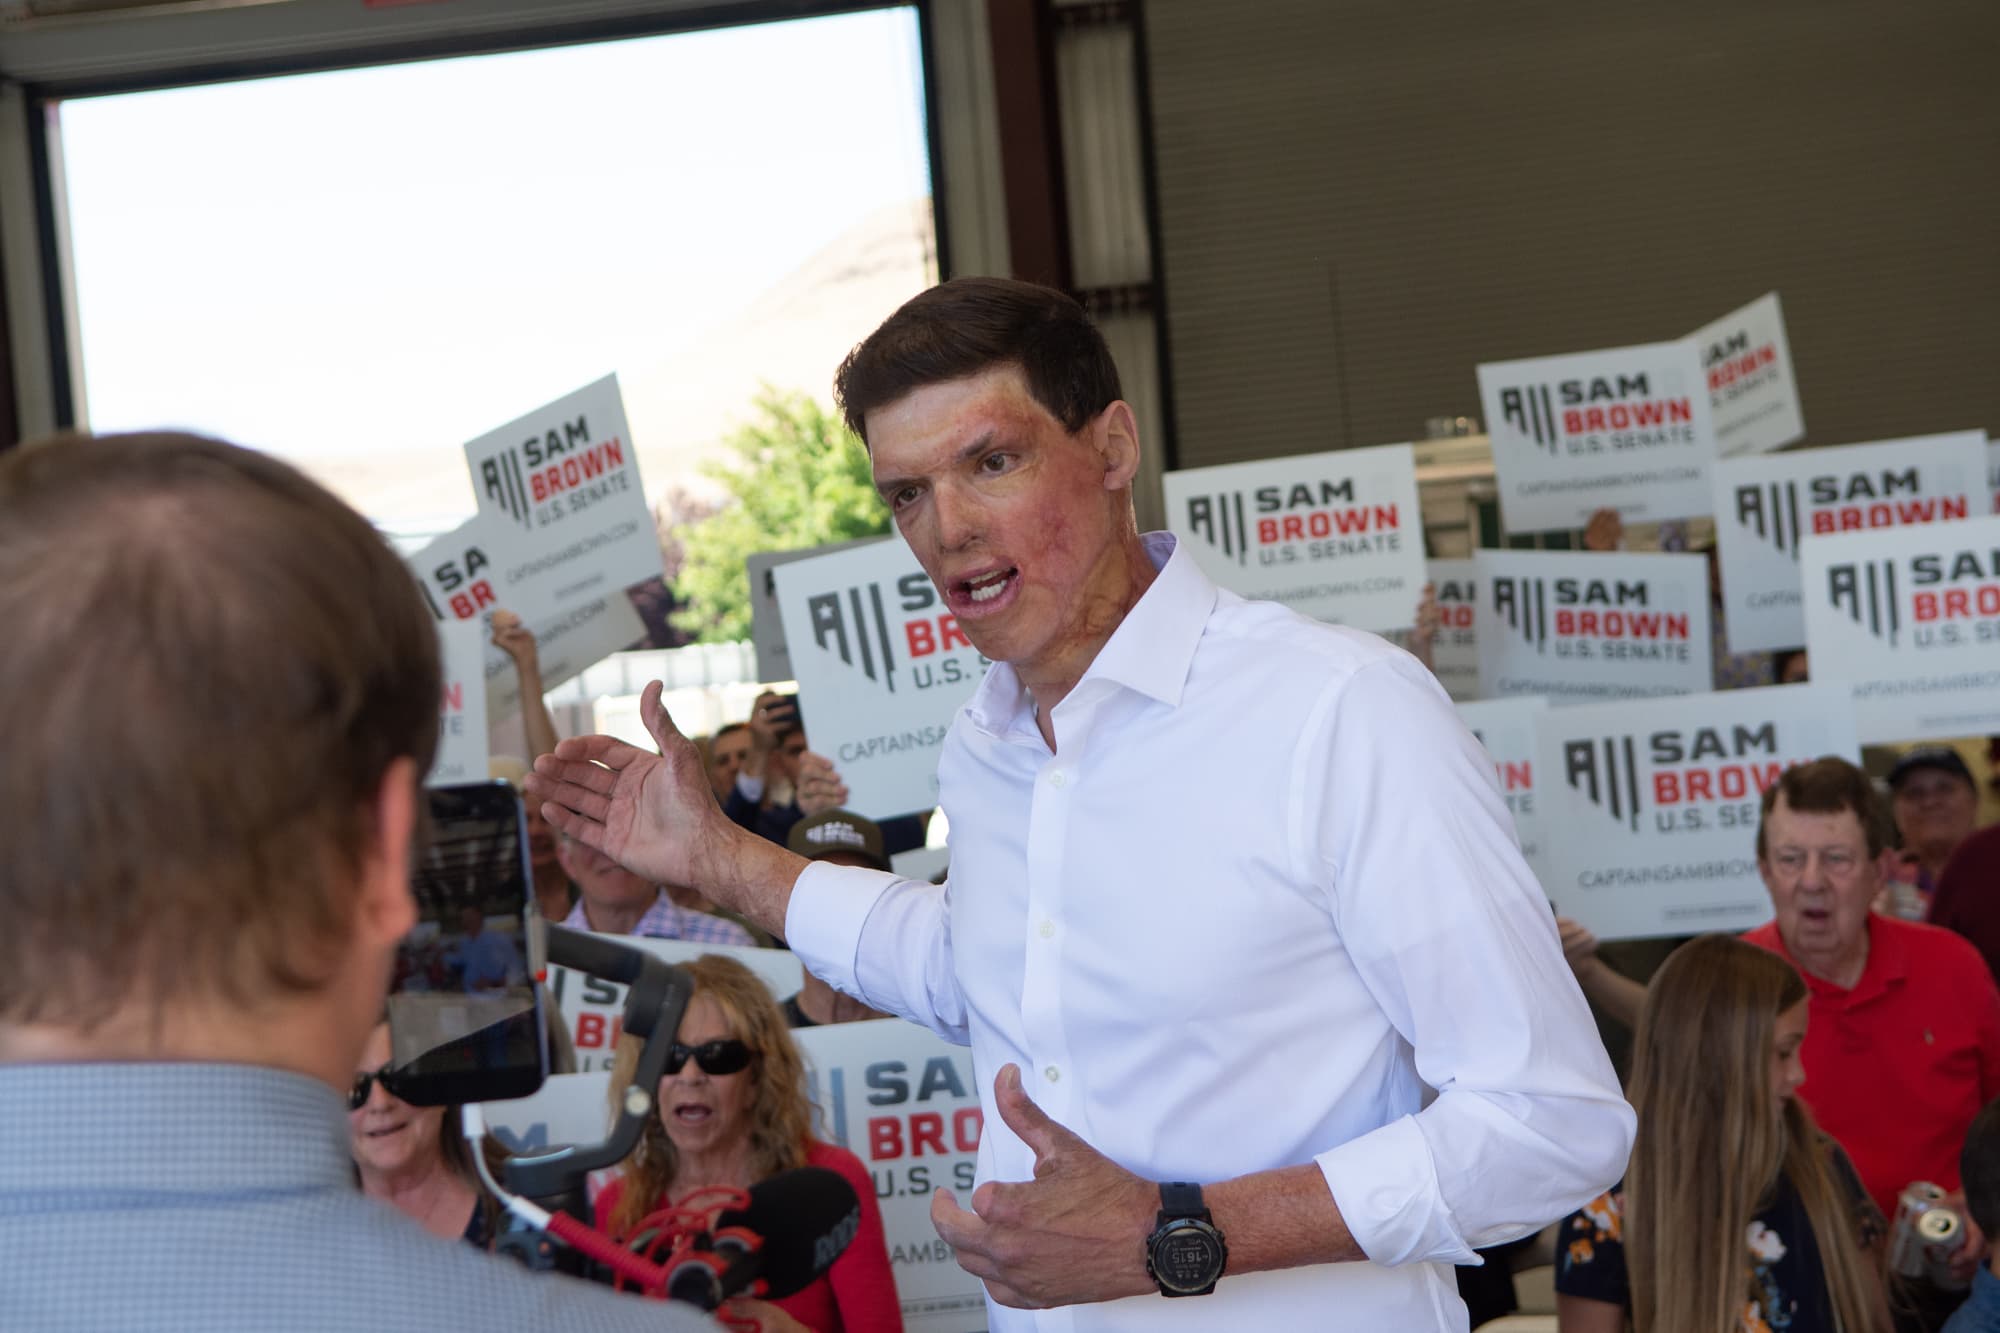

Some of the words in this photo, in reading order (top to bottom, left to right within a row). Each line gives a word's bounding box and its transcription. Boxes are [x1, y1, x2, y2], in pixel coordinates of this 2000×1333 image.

[1559, 371, 1649, 405] SAM
[1562, 397, 1693, 436] BROWN
[523, 414, 591, 468] SAM
[1611, 426, 1696, 451] SENATE
[529, 436, 625, 503] BROWN
[1809, 467, 1920, 505] SAM
[570, 469, 631, 513] SENATE
[1255, 477, 1355, 513] SAM
[1257, 502, 1400, 545] BROWN
[1812, 495, 1968, 536] BROWN
[1259, 545, 1304, 567] U.S.
[1308, 532, 1401, 560] SENATE
[434, 546, 490, 592] SA
[1554, 577, 1648, 605] SAM
[1555, 609, 1689, 640] BROWN
[1555, 640, 1593, 658] U.S.
[1601, 641, 1690, 663] SENATE
[912, 658, 971, 690] U.S.
[1650, 722, 1778, 764] SAM
[1653, 760, 1815, 806] BROW
[1656, 808, 1711, 834] U.S.
[865, 1055, 980, 1106] SA
[867, 1106, 984, 1161] BRO
[871, 1165, 940, 1199] U.S.
